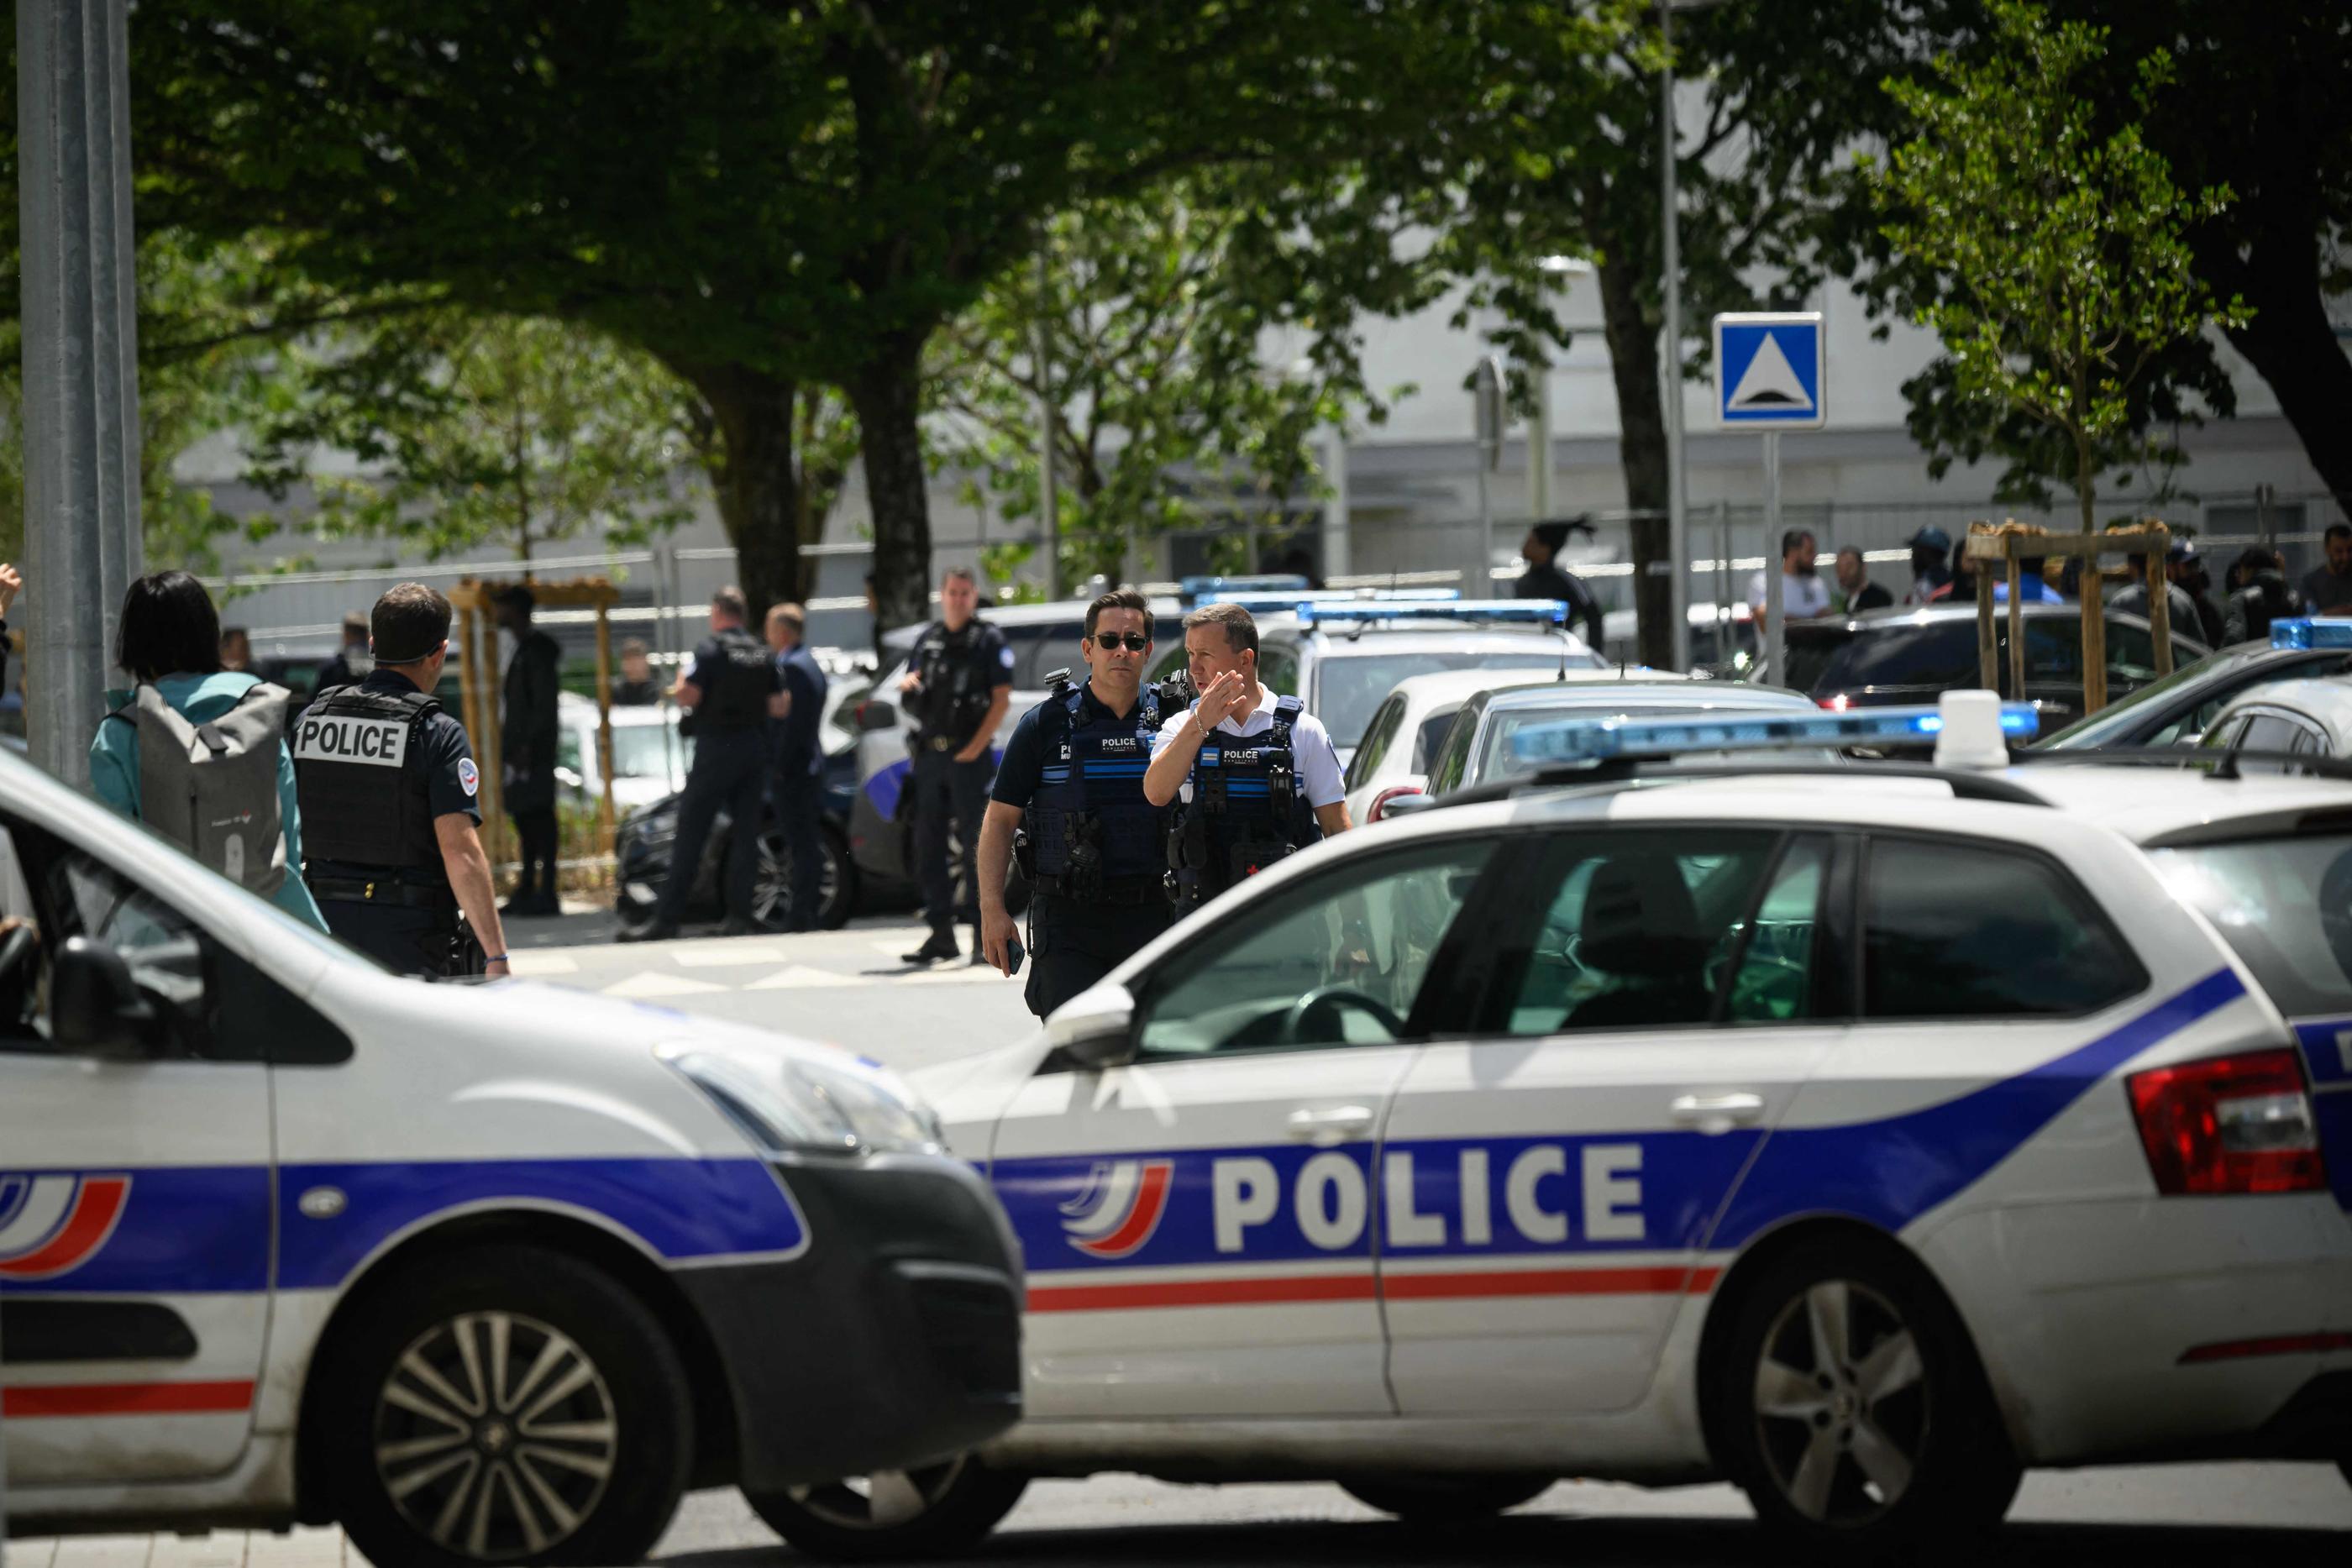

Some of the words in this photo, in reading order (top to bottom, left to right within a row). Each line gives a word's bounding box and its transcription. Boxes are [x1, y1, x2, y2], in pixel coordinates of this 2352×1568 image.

[300, 721, 400, 759] POLICE
[1102, 737, 1137, 747] POLICE
[1211, 1143, 1646, 1253] POLICE
